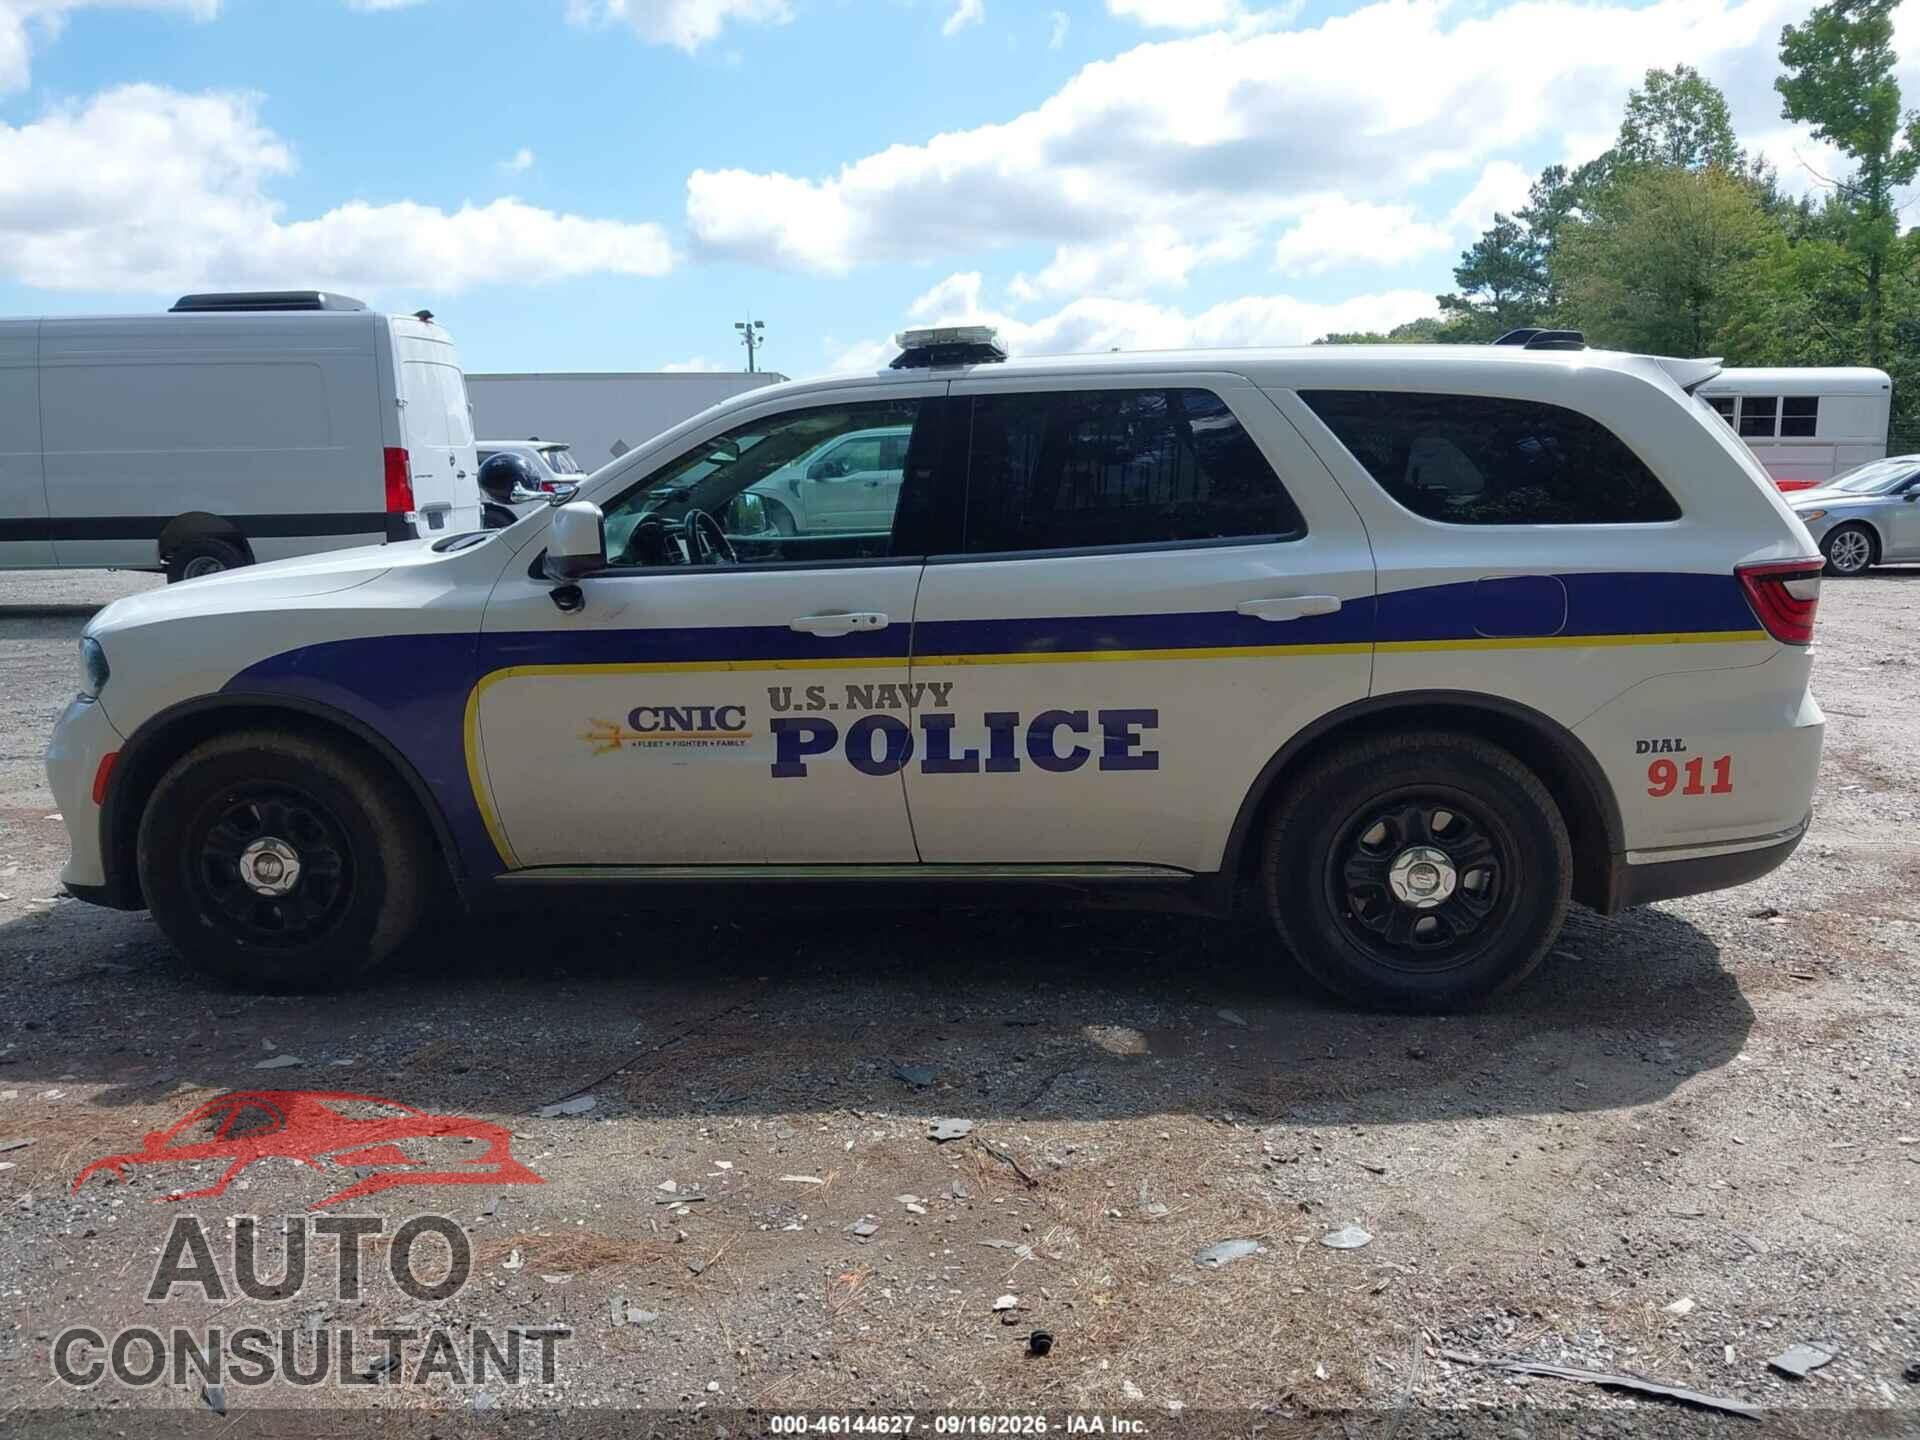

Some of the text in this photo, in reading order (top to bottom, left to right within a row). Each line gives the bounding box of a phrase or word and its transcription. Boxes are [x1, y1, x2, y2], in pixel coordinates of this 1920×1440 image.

[767, 682, 953, 712] U.S. NAVY
[628, 705, 746, 732] CNIC
[639, 739, 745, 748] FLEET FIGHTER FAMILY
[769, 708, 1159, 778] POLICE
[1636, 738, 1687, 754] DIAL
[1647, 755, 1733, 797] 911
